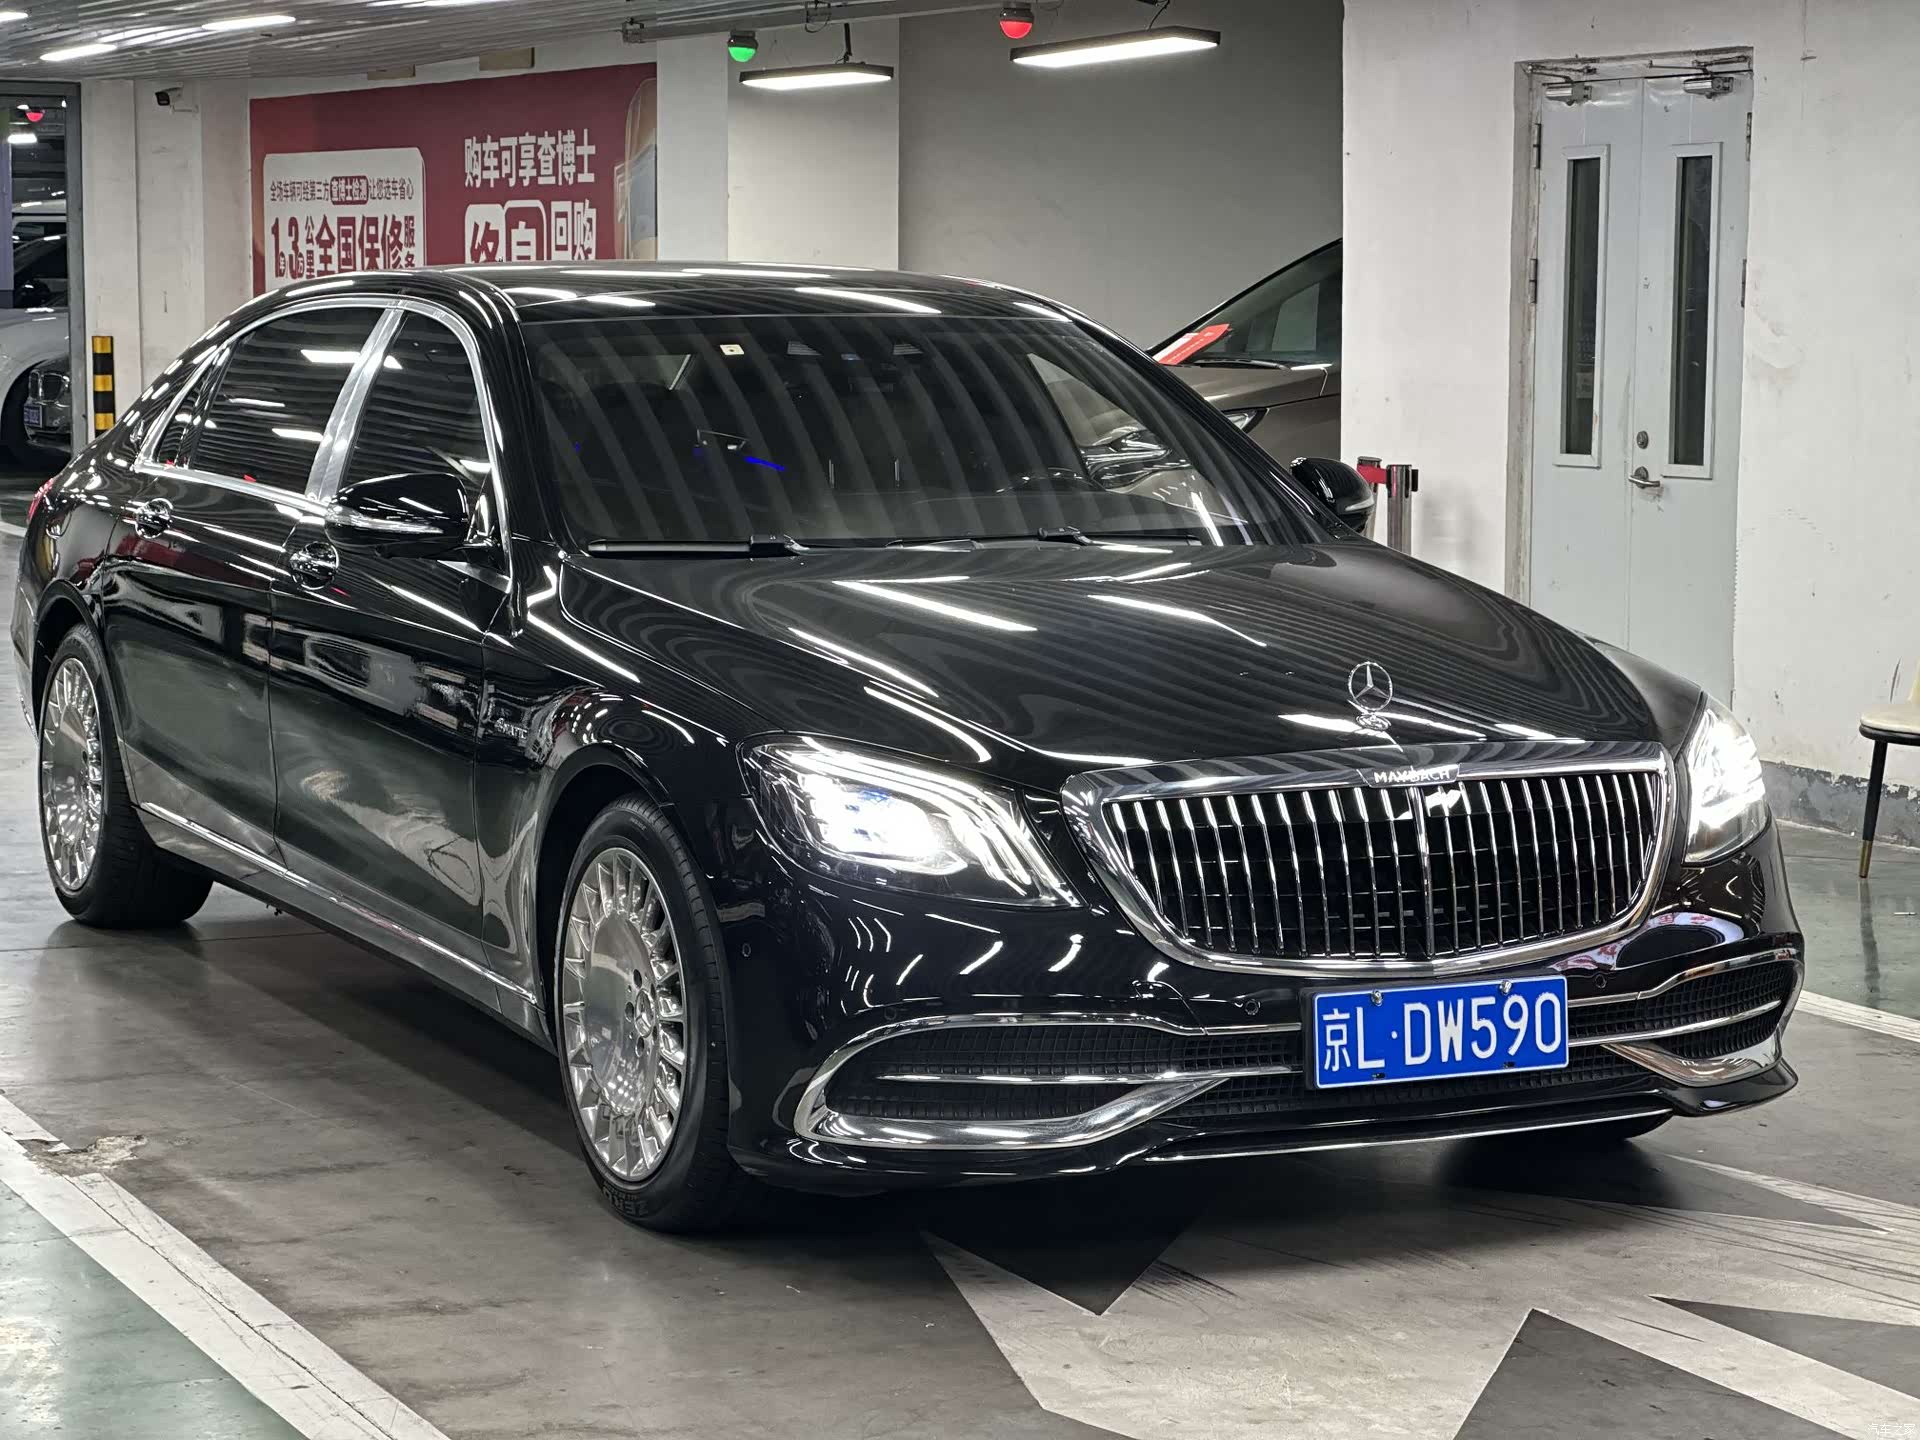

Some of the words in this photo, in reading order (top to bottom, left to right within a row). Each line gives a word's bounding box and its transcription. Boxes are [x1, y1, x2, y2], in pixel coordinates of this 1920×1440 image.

[464, 128, 596, 189] 购车可享查博士
[1373, 768, 1450, 784] MAYBACH
[1322, 991, 1562, 1072] 京L·DW590
